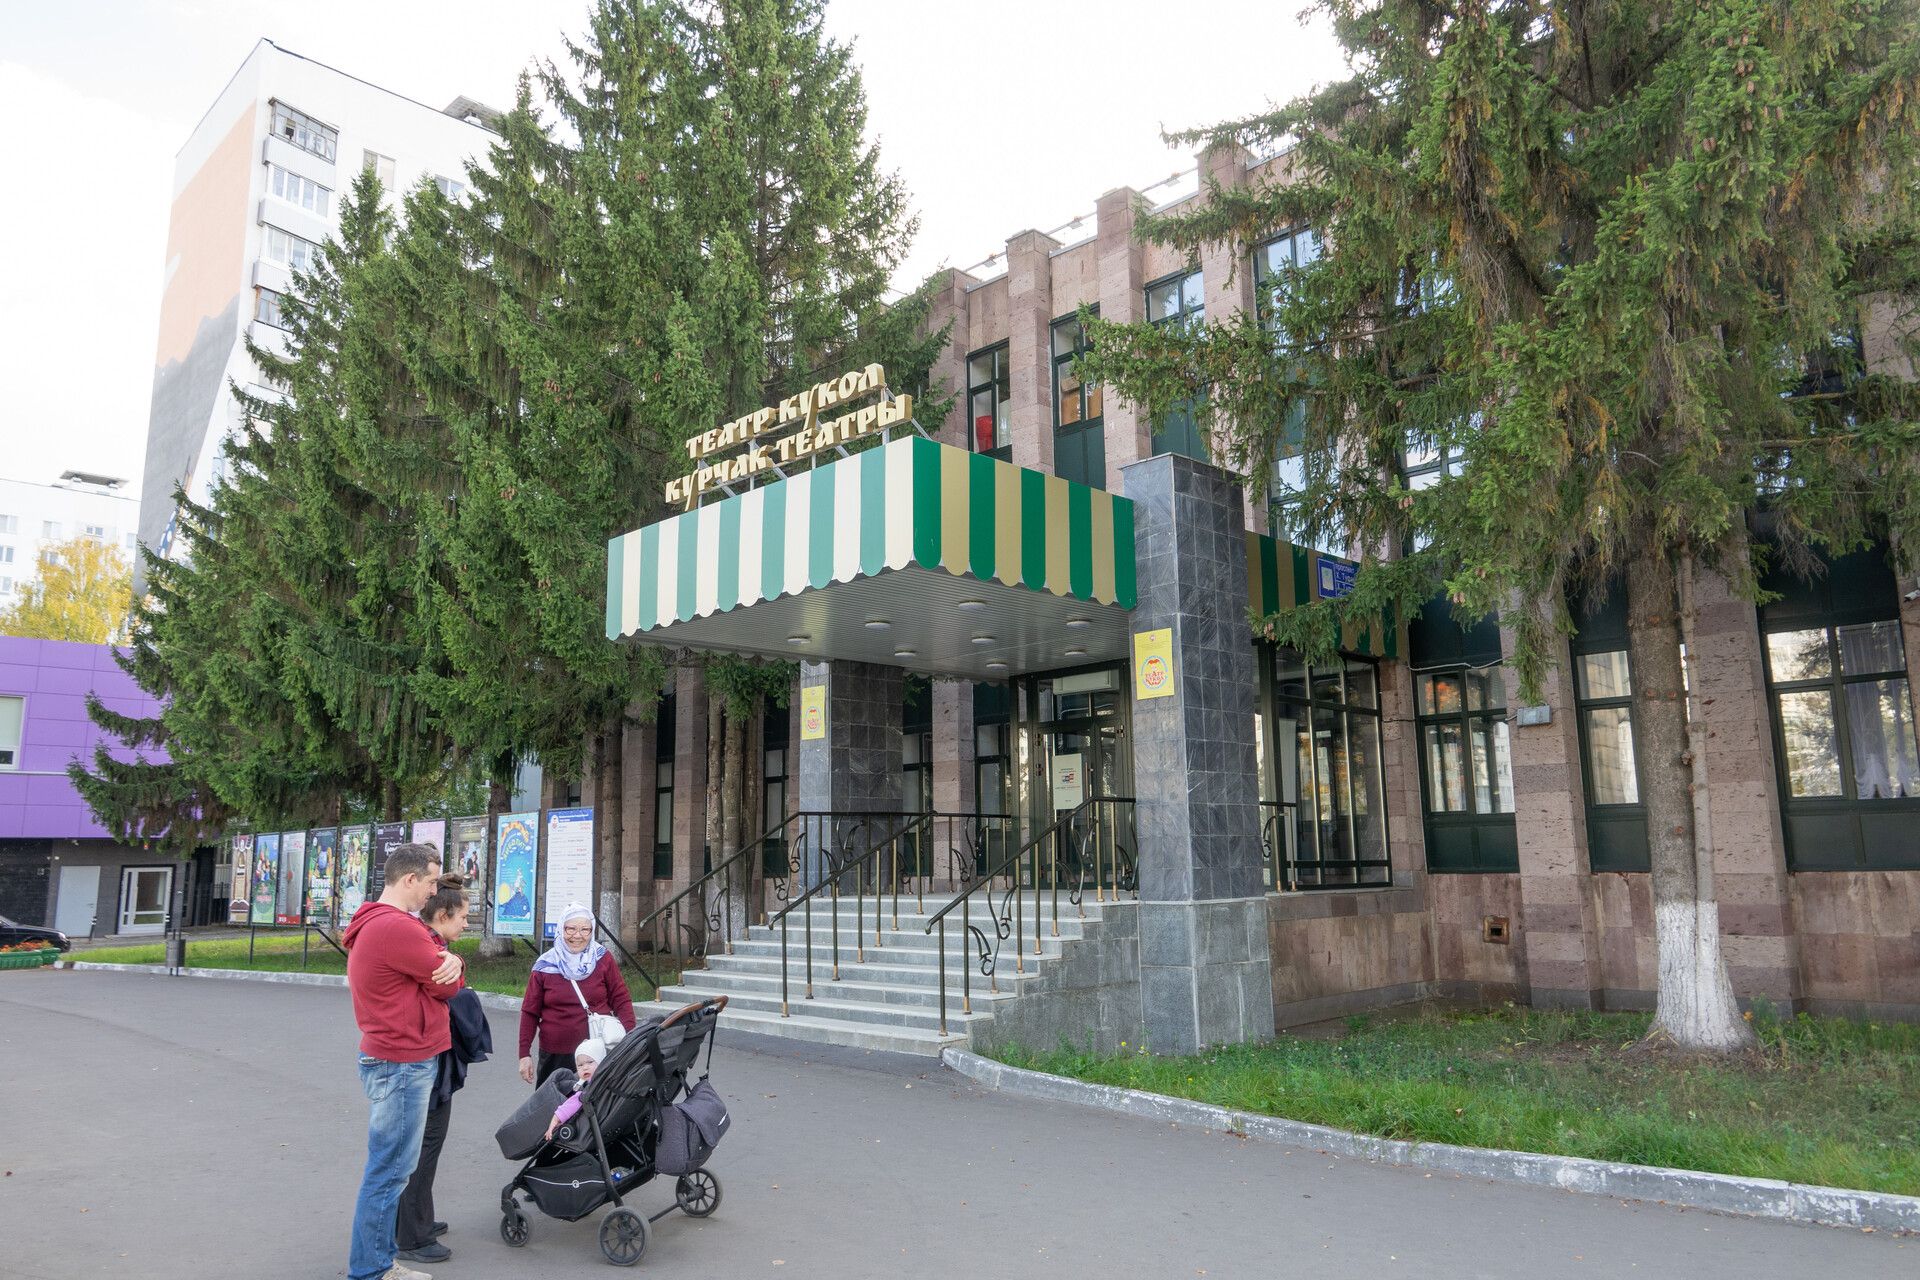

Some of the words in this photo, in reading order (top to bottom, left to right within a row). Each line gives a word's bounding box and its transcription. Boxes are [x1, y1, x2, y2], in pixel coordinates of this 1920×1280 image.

[665, 445, 774, 511] КУРЧАК
[776, 394, 912, 462] ТЕАТРЫ
[686, 407, 776, 459] ТЕАТР
[779, 363, 885, 430] КУКОЛ
